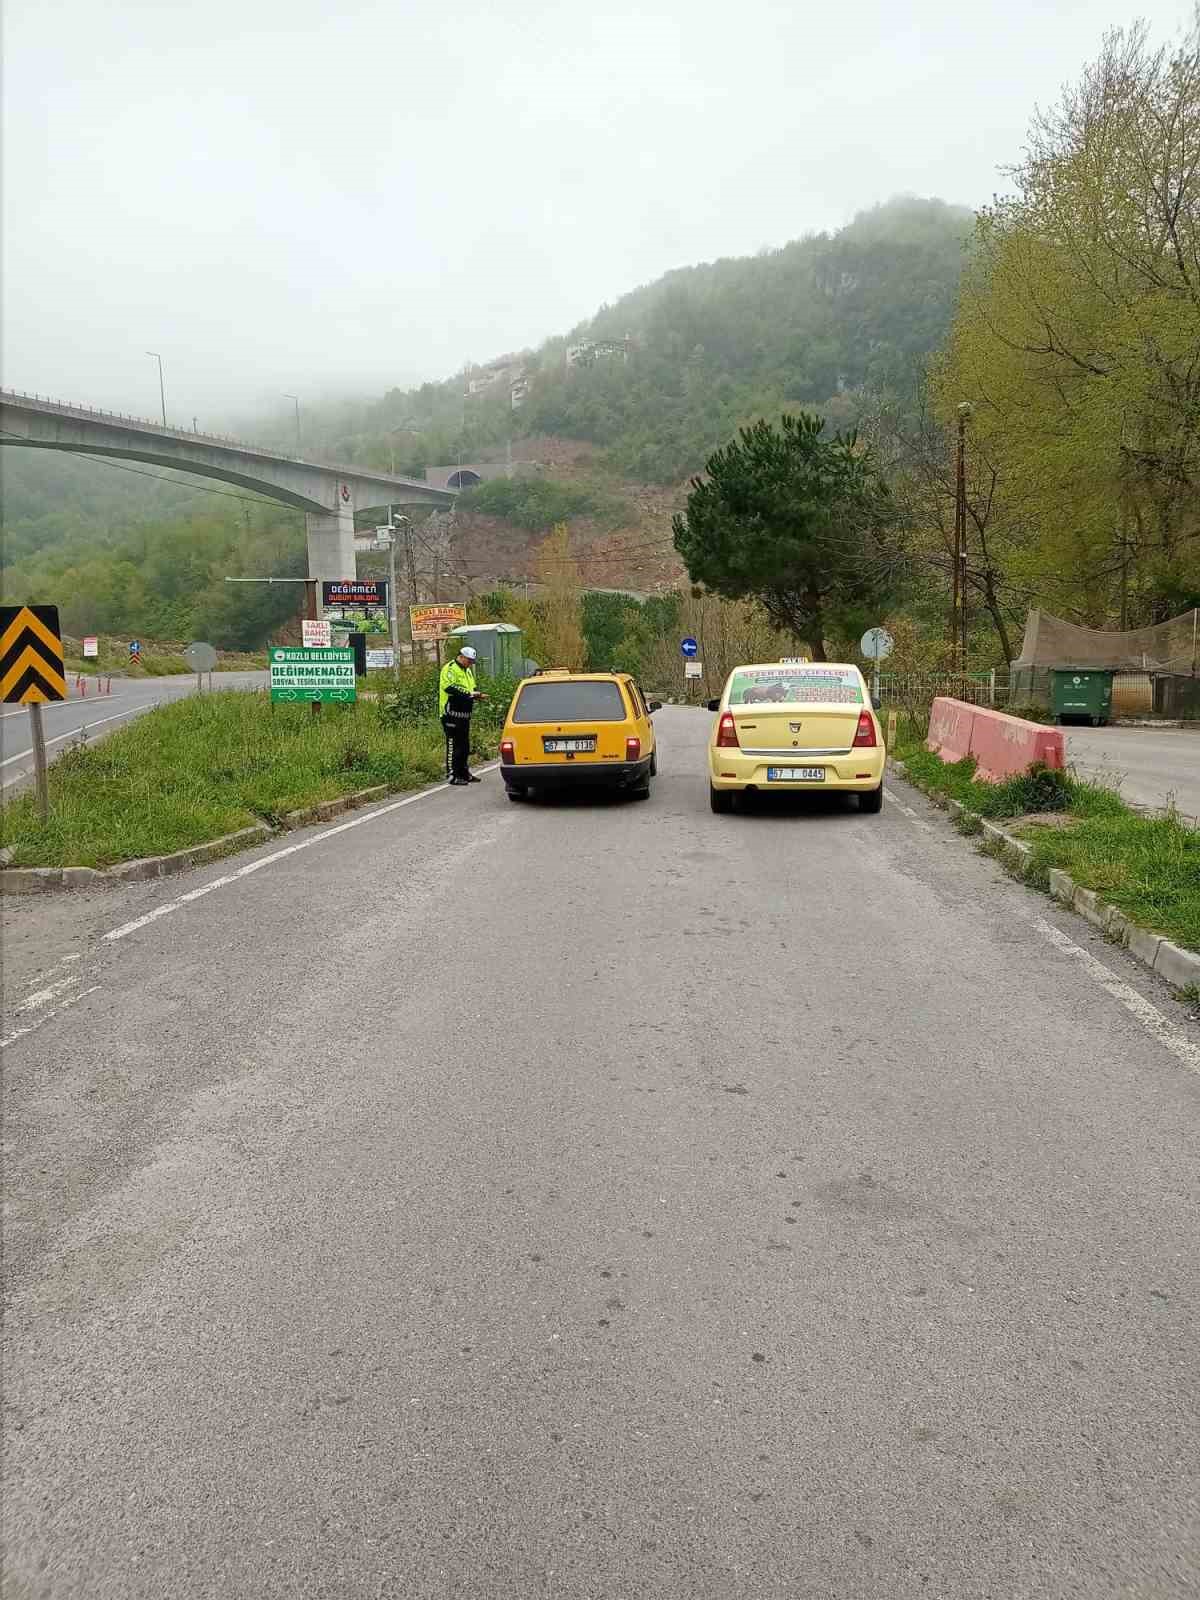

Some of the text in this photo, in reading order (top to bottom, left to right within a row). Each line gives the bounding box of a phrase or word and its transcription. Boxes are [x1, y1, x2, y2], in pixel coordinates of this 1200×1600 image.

[286, 650, 352, 661] KOZLU BELEDİYESİ
[272, 678, 296, 686] SOSYAL
[802, 768, 823, 778] 0445
